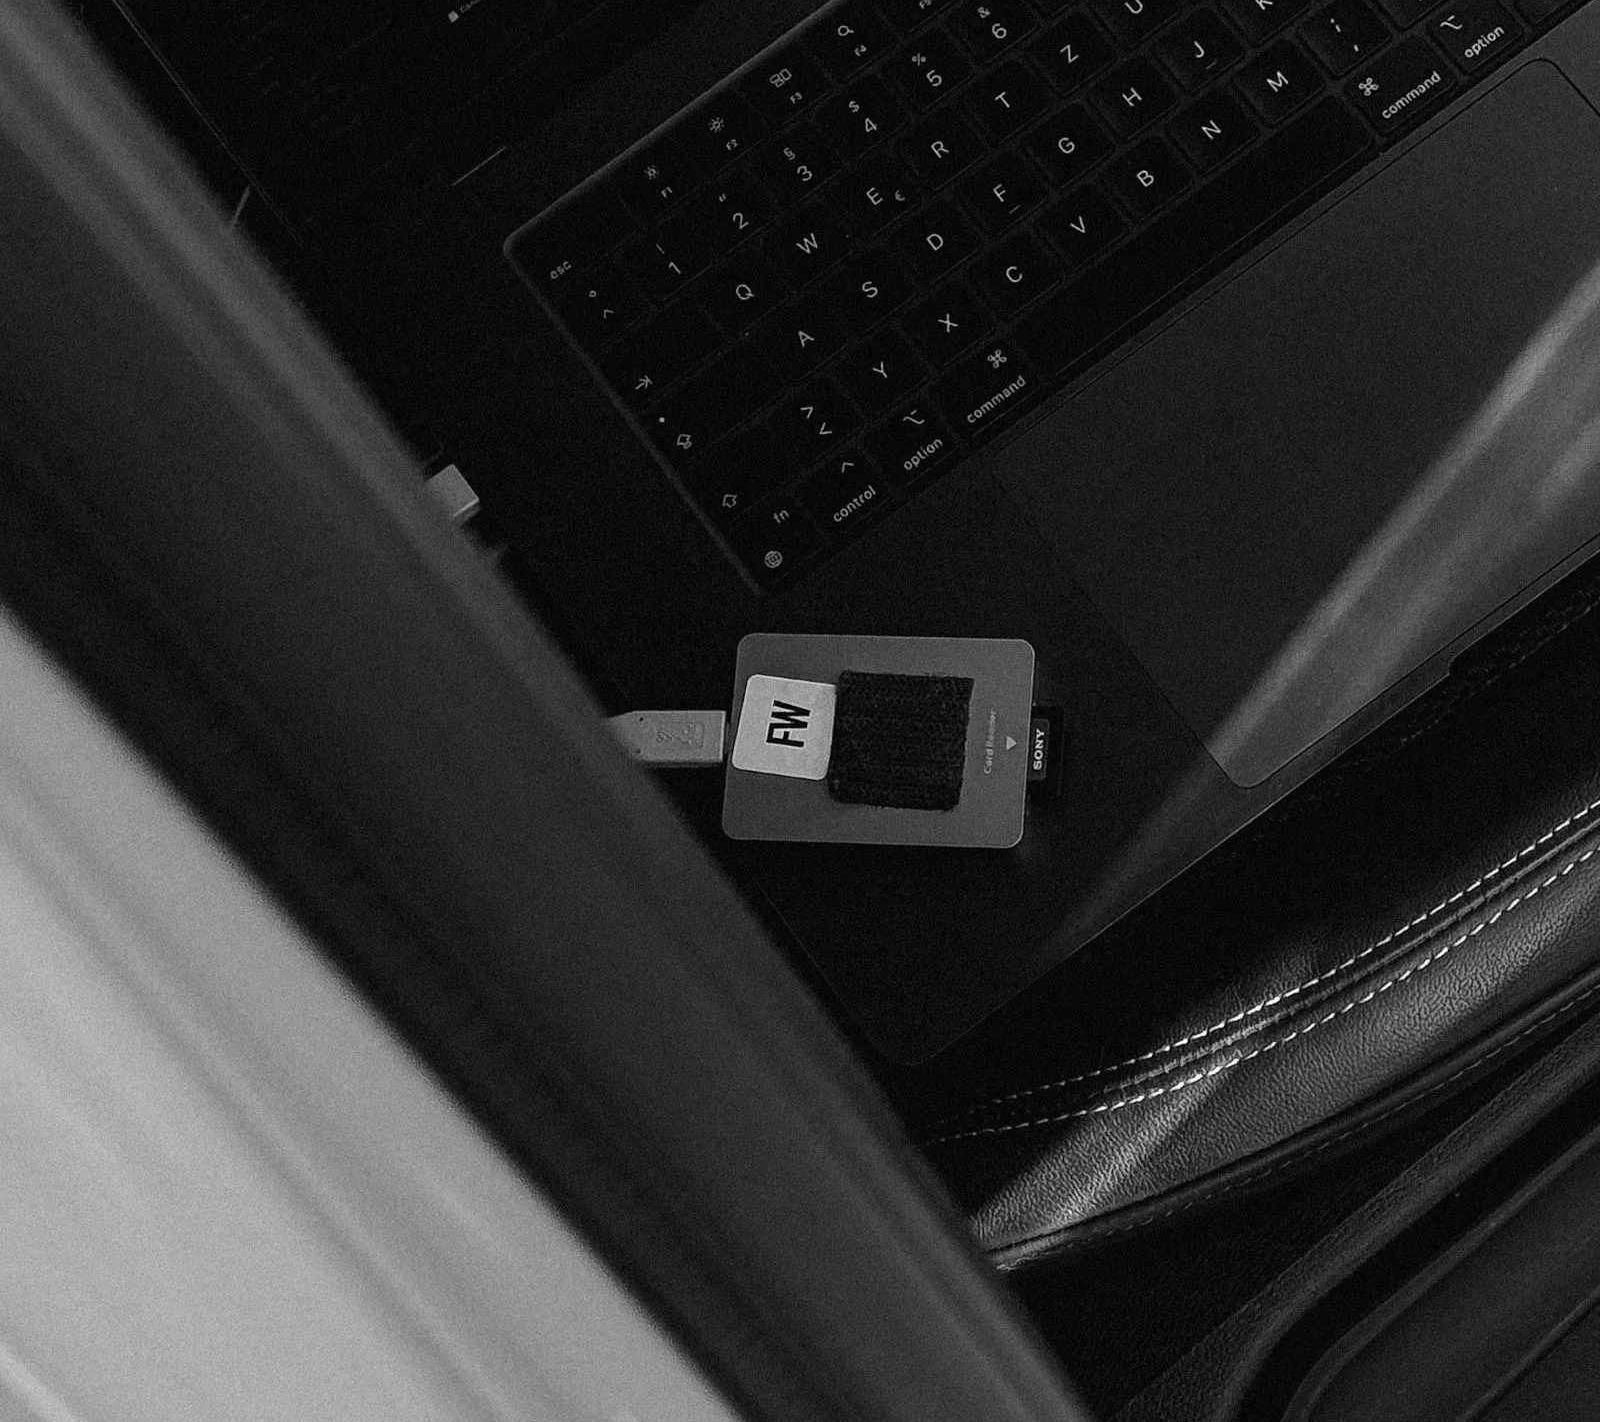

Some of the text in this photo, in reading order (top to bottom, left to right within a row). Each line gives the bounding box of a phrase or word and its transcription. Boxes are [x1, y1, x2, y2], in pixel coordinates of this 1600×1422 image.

[991, 23, 1007, 39] 6
[1194, 41, 1205, 58] J
[1464, 26, 1504, 58] option
[1059, 44, 1079, 63] Z
[926, 69, 942, 87] 5
[1266, 71, 1288, 92] M
[994, 91, 1010, 108] T
[1122, 87, 1142, 106] H
[1381, 71, 1441, 119] command
[864, 117, 877, 132] 4
[1201, 120, 1221, 139] N
[930, 140, 949, 158] R
[1057, 137, 1075, 154] G
[796, 165, 812, 182] 3
[1136, 169, 1154, 187] B
[866, 187, 883, 205] E
[993, 183, 1006, 202] F
[732, 212, 749, 229] 2
[1070, 216, 1086, 233] V
[796, 232, 818, 254] W
[926, 233, 943, 251] D
[550, 260, 571, 279] esc
[668, 261, 681, 274] 1
[1005, 266, 1022, 283] C
[735, 283, 754, 301] Q
[861, 280, 878, 298] S
[938, 313, 958, 333] X
[798, 330, 814, 347] A
[872, 361, 887, 378] Y
[966, 375, 1026, 423] command
[903, 438, 943, 470] option
[833, 485, 876, 522] control
[773, 510, 789, 523] fn
[766, 699, 811, 748] FW
[1032, 728, 1046, 771] SONY
[983, 745, 995, 775] Card
